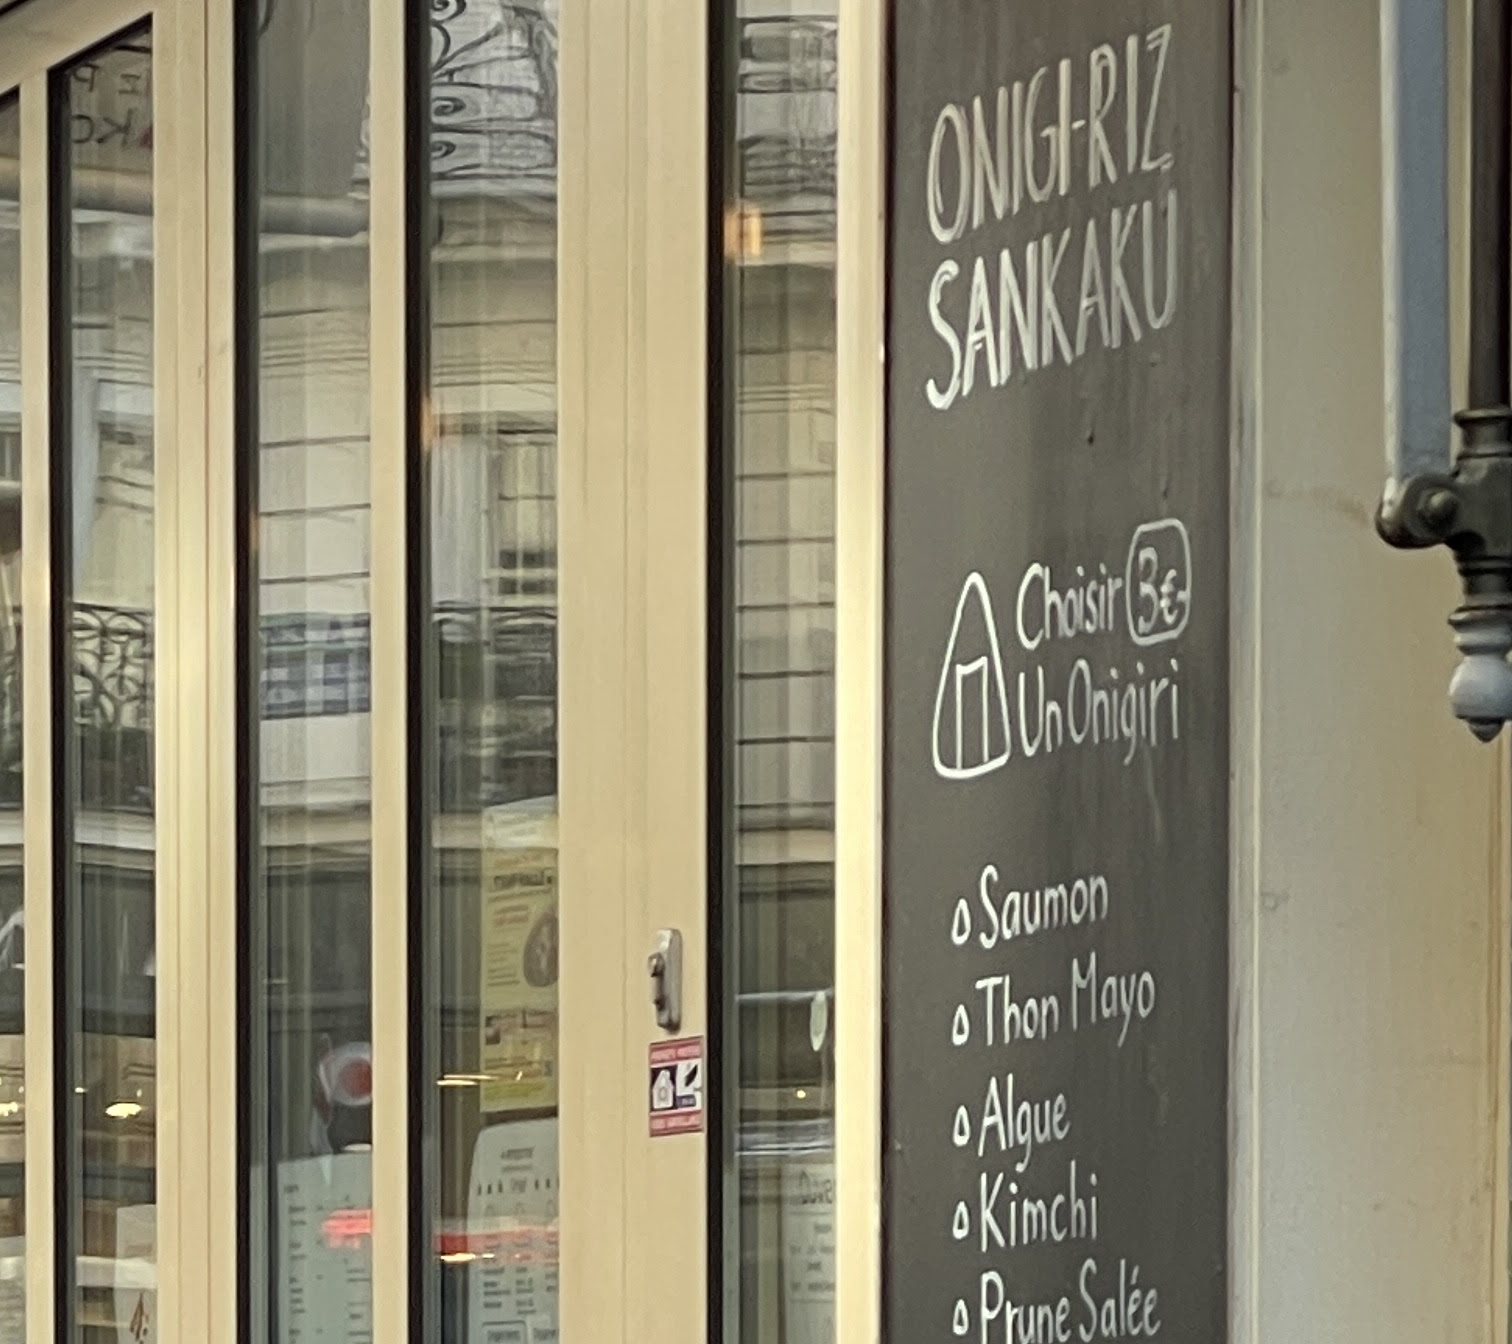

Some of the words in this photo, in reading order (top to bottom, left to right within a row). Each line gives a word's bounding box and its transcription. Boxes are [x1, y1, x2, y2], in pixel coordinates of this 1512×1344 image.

[927, 24, 1173, 244] ONIGI-RIZ
[925, 189, 1178, 411] SANKAKU
[1017, 562, 1124, 650] Choisir
[979, 865, 1108, 949] Saumon
[975, 975, 1058, 1046] Thon
[1072, 951, 1155, 1048] Mayo
[978, 1073, 1069, 1172] Algue
[980, 1160, 1097, 1252] Kimchi
[1079, 1258, 1161, 1343] Salée
